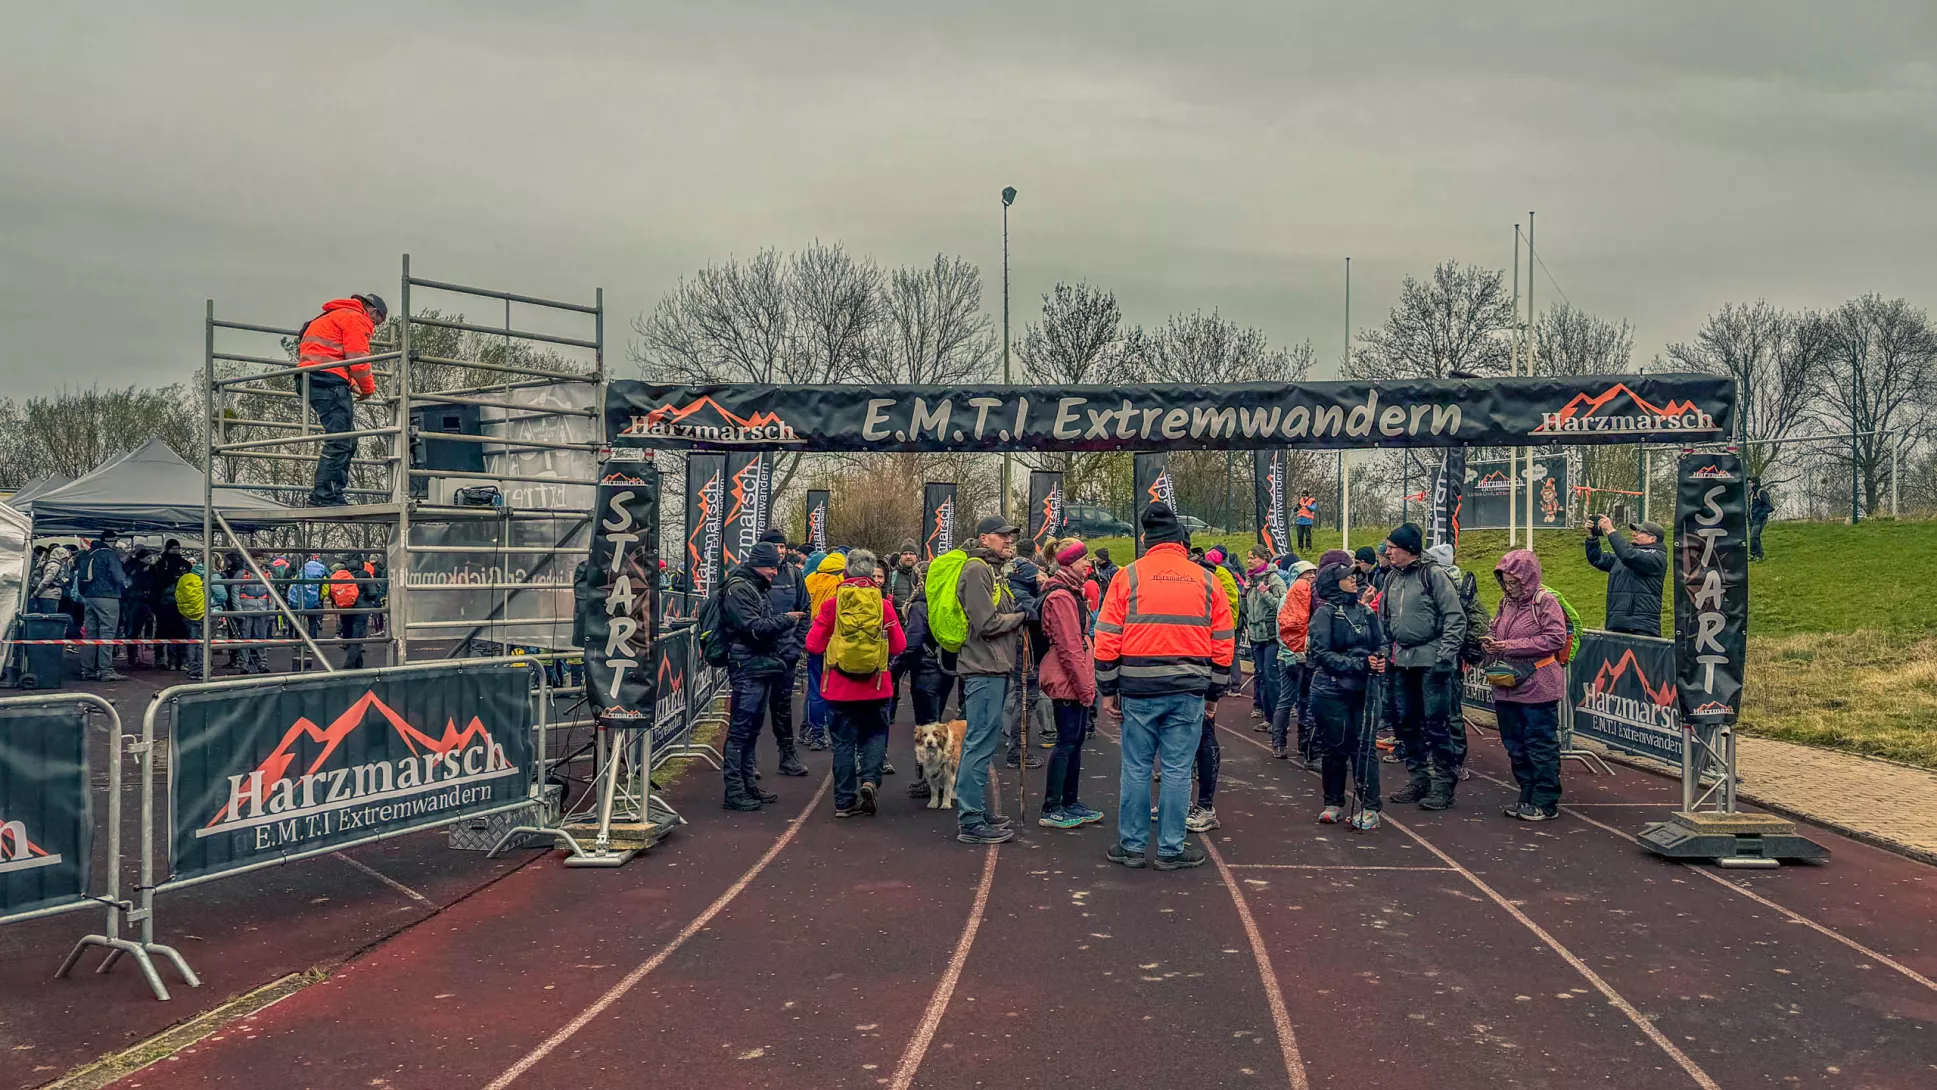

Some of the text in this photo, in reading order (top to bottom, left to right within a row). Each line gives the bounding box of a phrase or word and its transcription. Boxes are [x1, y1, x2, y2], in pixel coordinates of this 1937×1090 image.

[629, 415, 794, 441] Harzmarsch
[862, 388, 1462, 442] E.M.T.I Extremwandern
[1541, 409, 1713, 432] Harzmarsch
[602, 490, 639, 699] START
[1694, 485, 1729, 694] START
[1583, 682, 1682, 733] Harzmarsc
[224, 733, 509, 823] Harzmarsch
[254, 783, 492, 850] E.M.T.I Extremwandern
